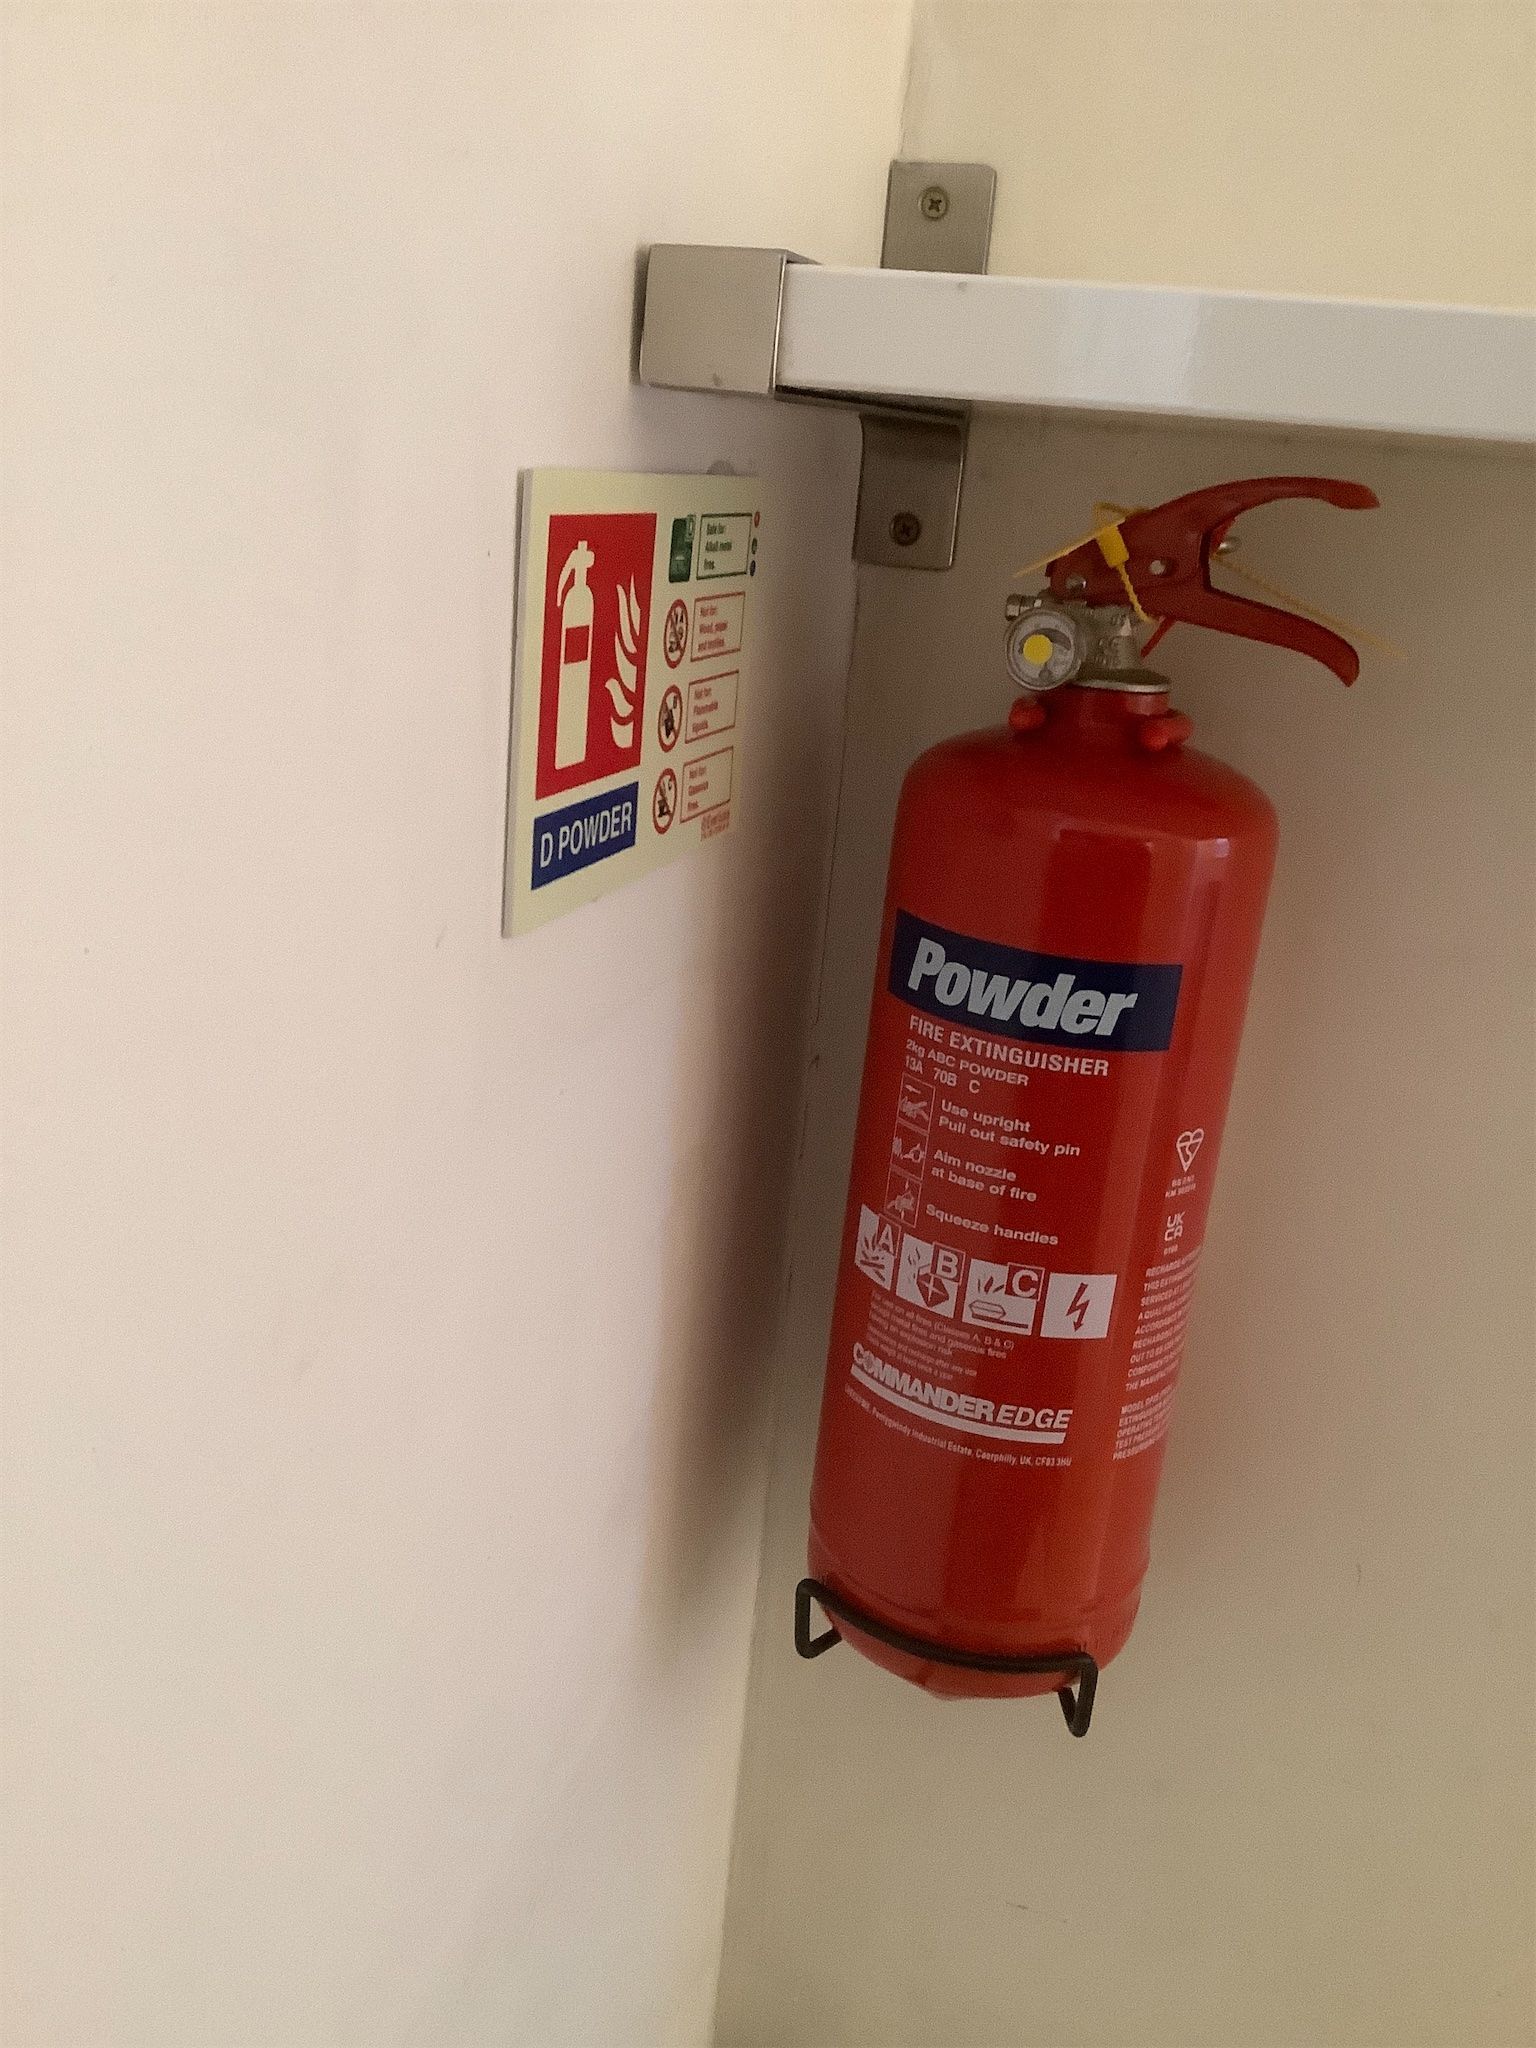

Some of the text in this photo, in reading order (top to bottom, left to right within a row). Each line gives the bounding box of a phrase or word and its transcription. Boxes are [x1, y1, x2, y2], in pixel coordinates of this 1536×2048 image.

[540, 800, 633, 869] D POWDER
[907, 937, 1139, 1036] Powder
[906, 1038, 1030, 1087] 2kg ABC POWDER
[909, 1014, 1110, 1077] FIRE EXTINGUISHER
[905, 1056, 981, 1094] 13A 70B C
[941, 1099, 1031, 1133] Use upright
[938, 1115, 1081, 1157] Pull out safety pin
[931, 1166, 1038, 1202] at base of fire
[933, 1149, 1017, 1182] Aim nozzle
[926, 1203, 1059, 1246] Squeeze handles
[1164, 1225, 1183, 1242] CA
[1166, 1210, 1186, 1228] UK
[877, 1223, 895, 1256] A
[937, 1249, 959, 1279] B
[1011, 1269, 1038, 1298] C
[853, 1342, 996, 1424] COMMANDER
[996, 1404, 1074, 1430] EDGE
